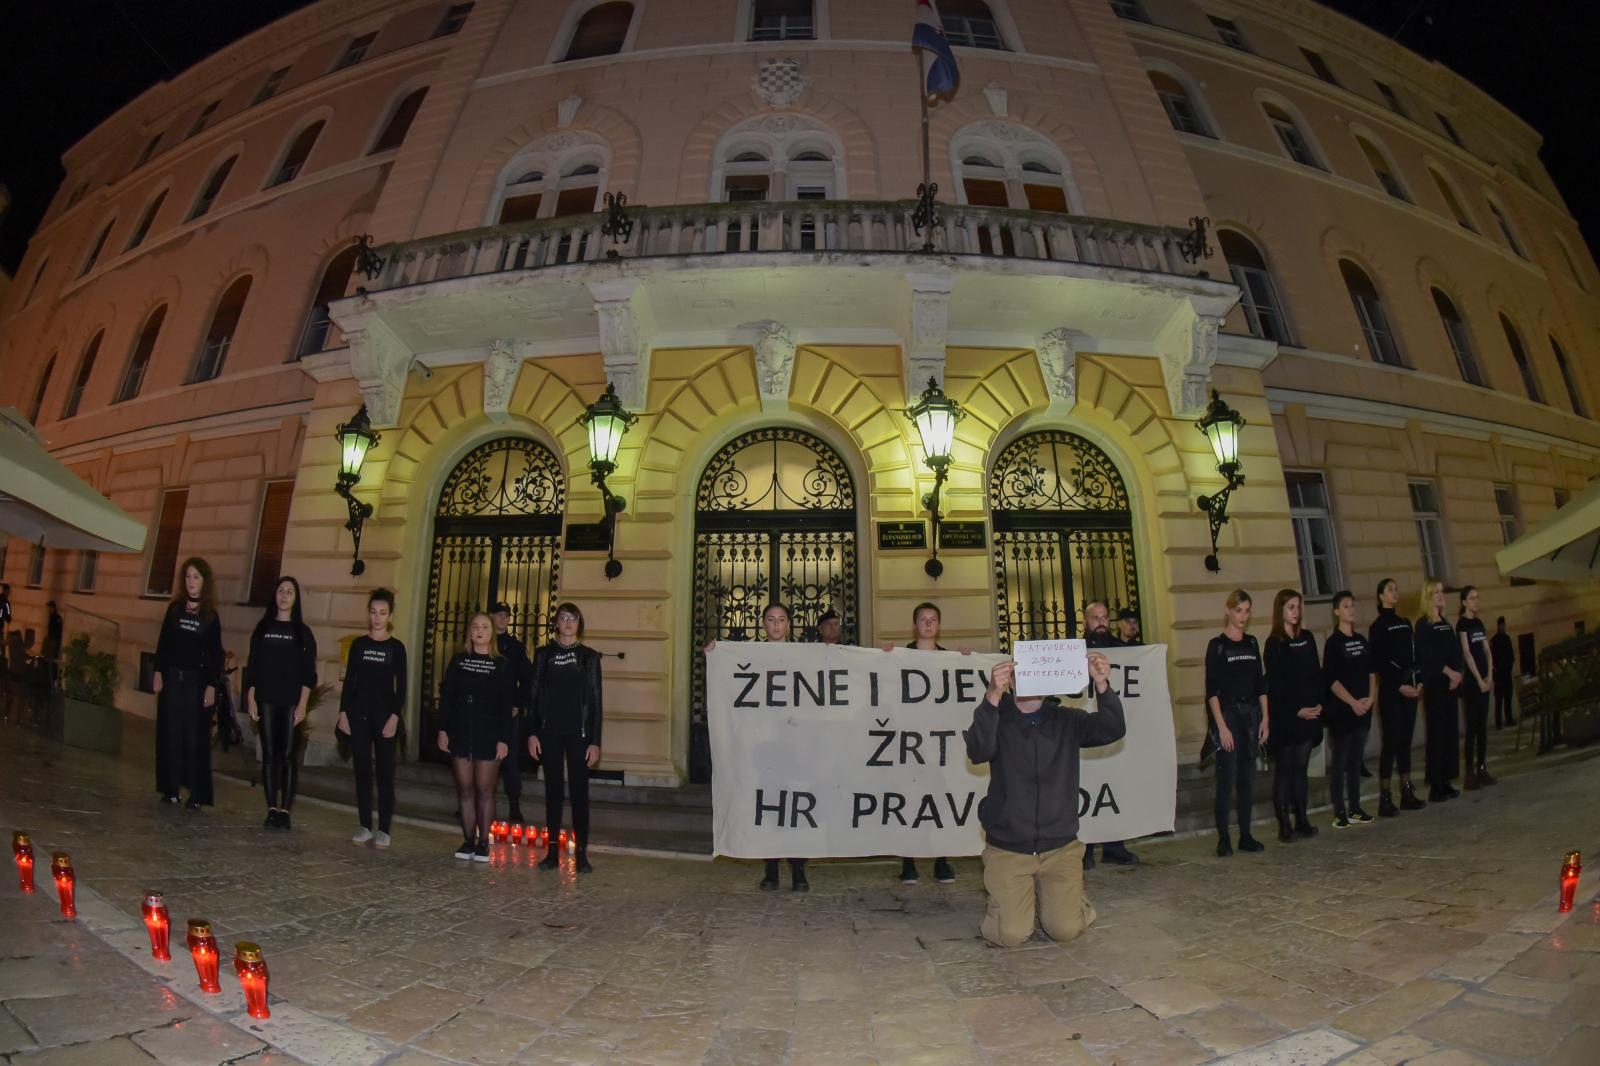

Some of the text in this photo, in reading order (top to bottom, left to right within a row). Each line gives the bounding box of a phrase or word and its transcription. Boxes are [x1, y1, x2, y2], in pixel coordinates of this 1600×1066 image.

[733, 662, 849, 708] ŽENE
[869, 671, 879, 707] I
[866, 717, 969, 767] ŽRT
[754, 788, 818, 829] HR
